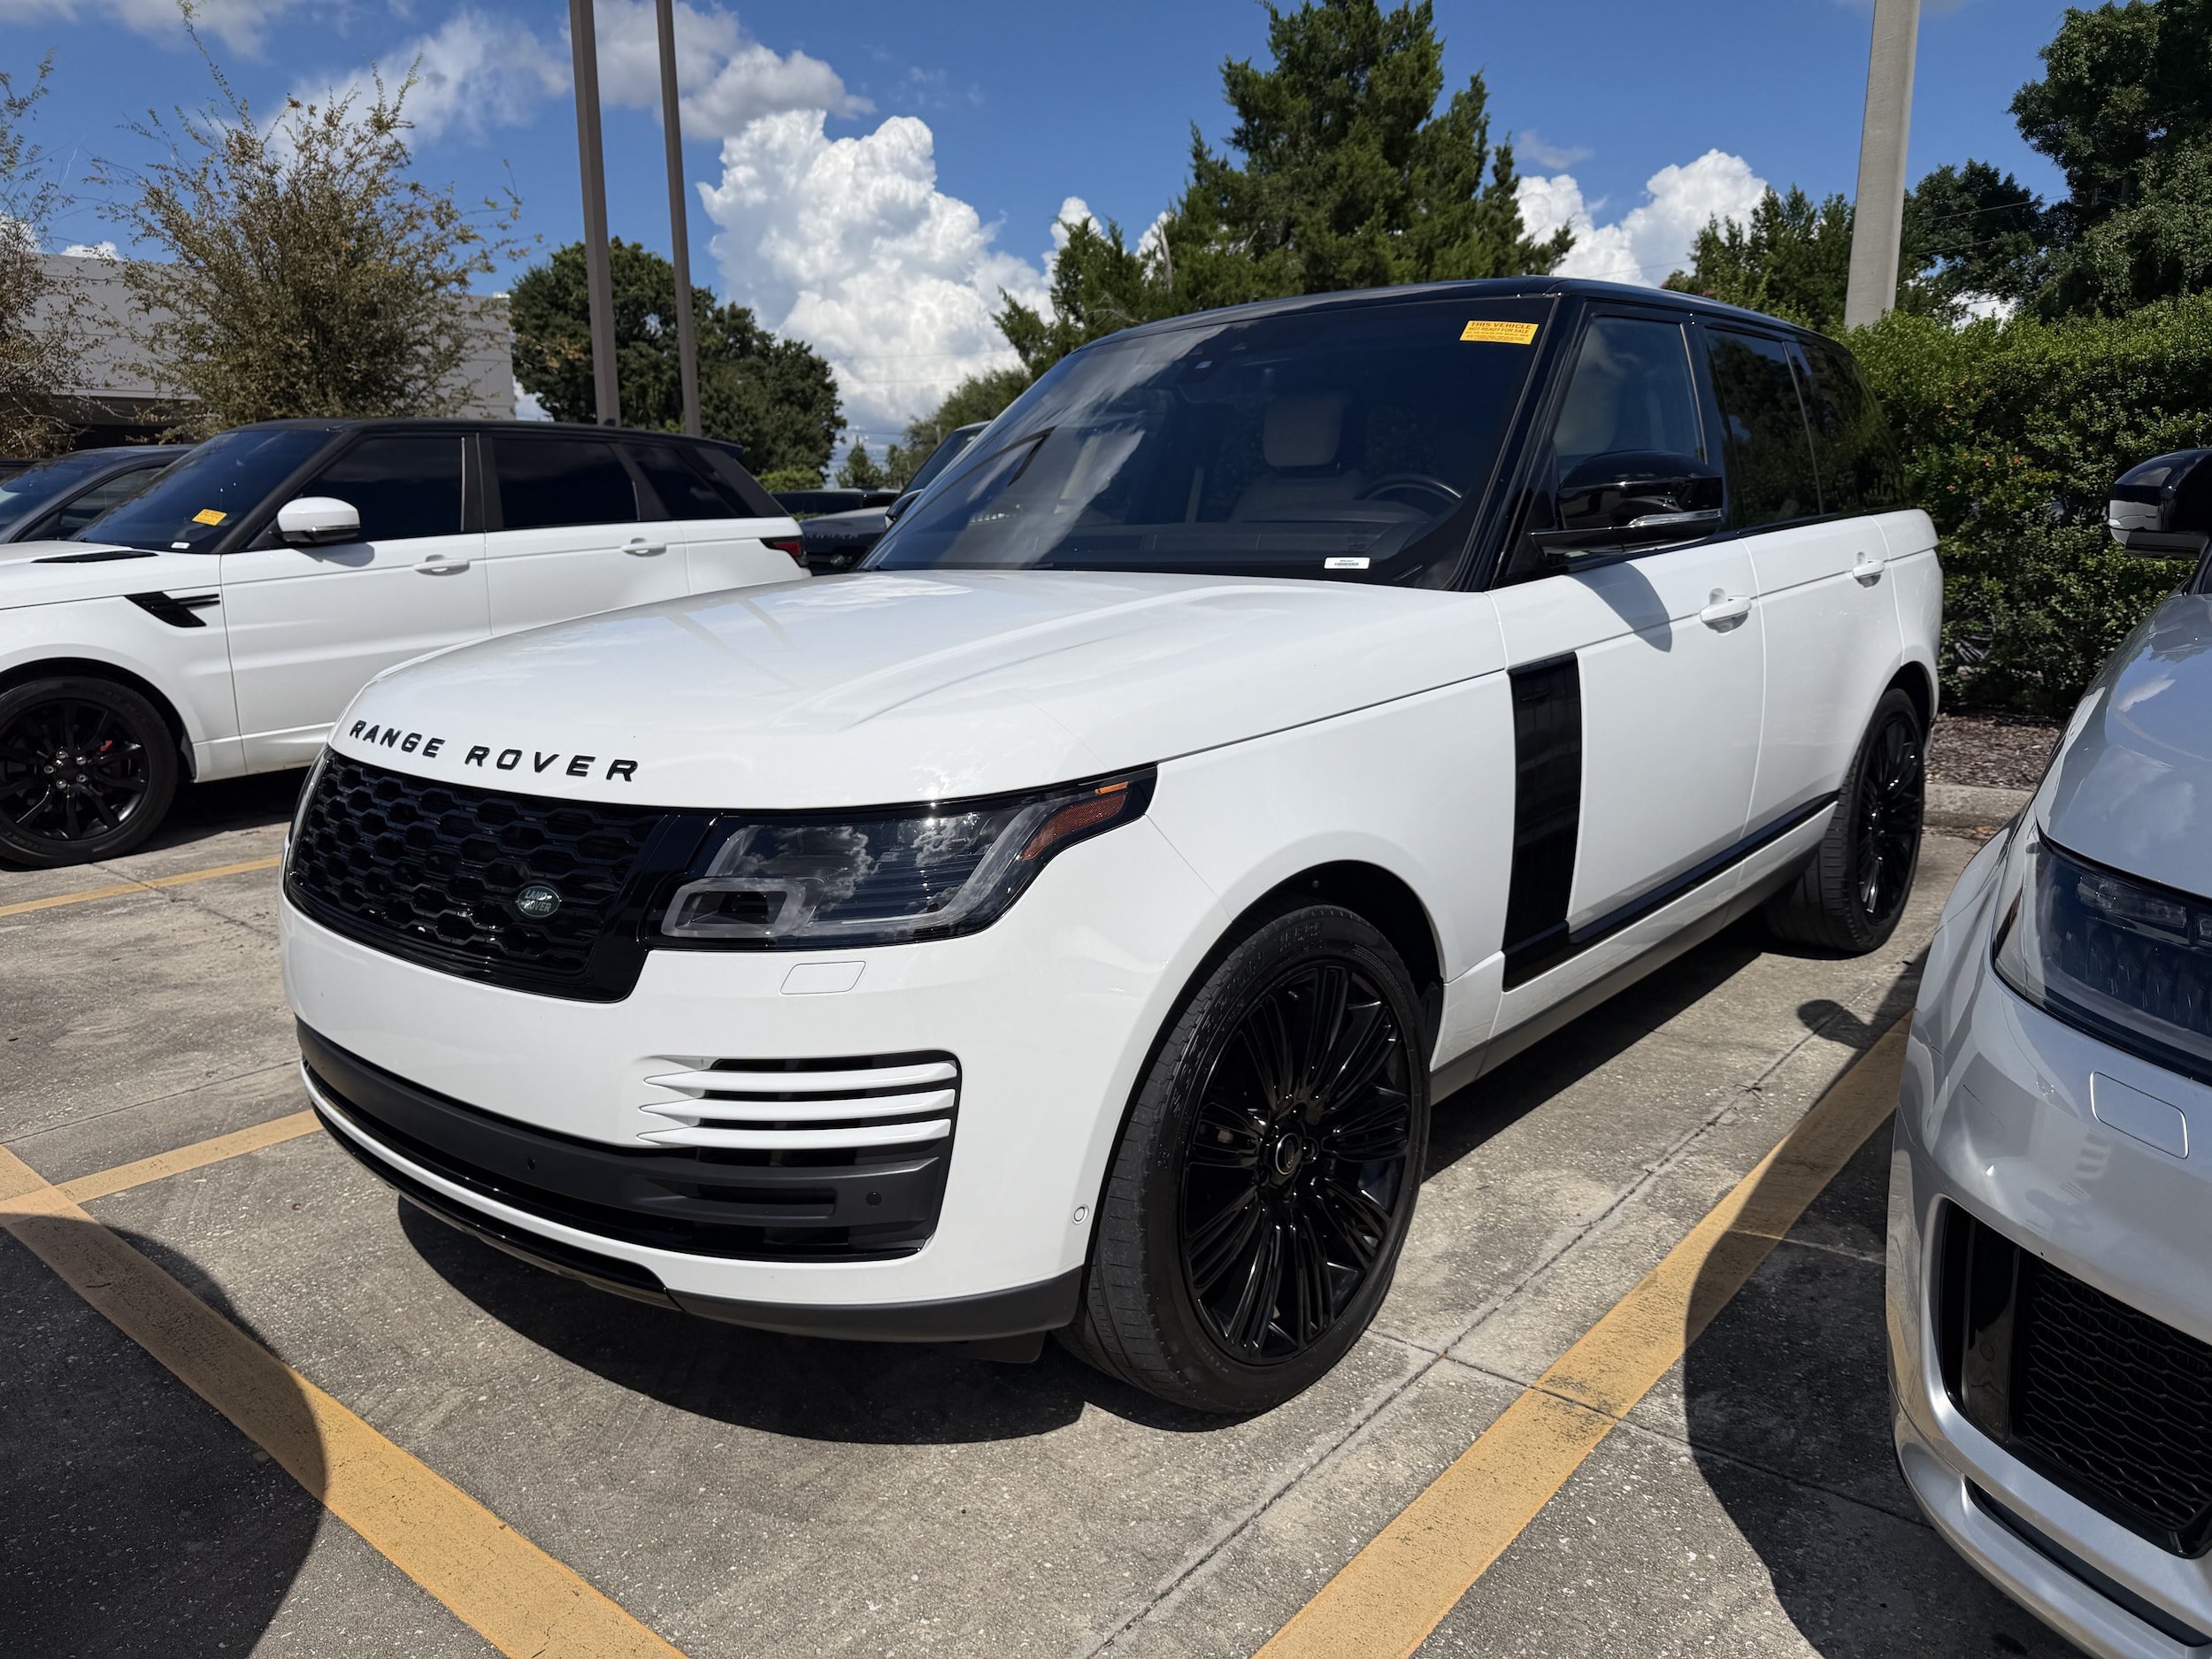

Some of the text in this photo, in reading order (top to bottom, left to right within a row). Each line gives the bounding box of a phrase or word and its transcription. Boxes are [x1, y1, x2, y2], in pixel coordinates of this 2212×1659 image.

[349, 719, 639, 782] RANGE ROVER
[525, 890, 548, 901] LAND
[524, 900, 551, 912] ROVER
